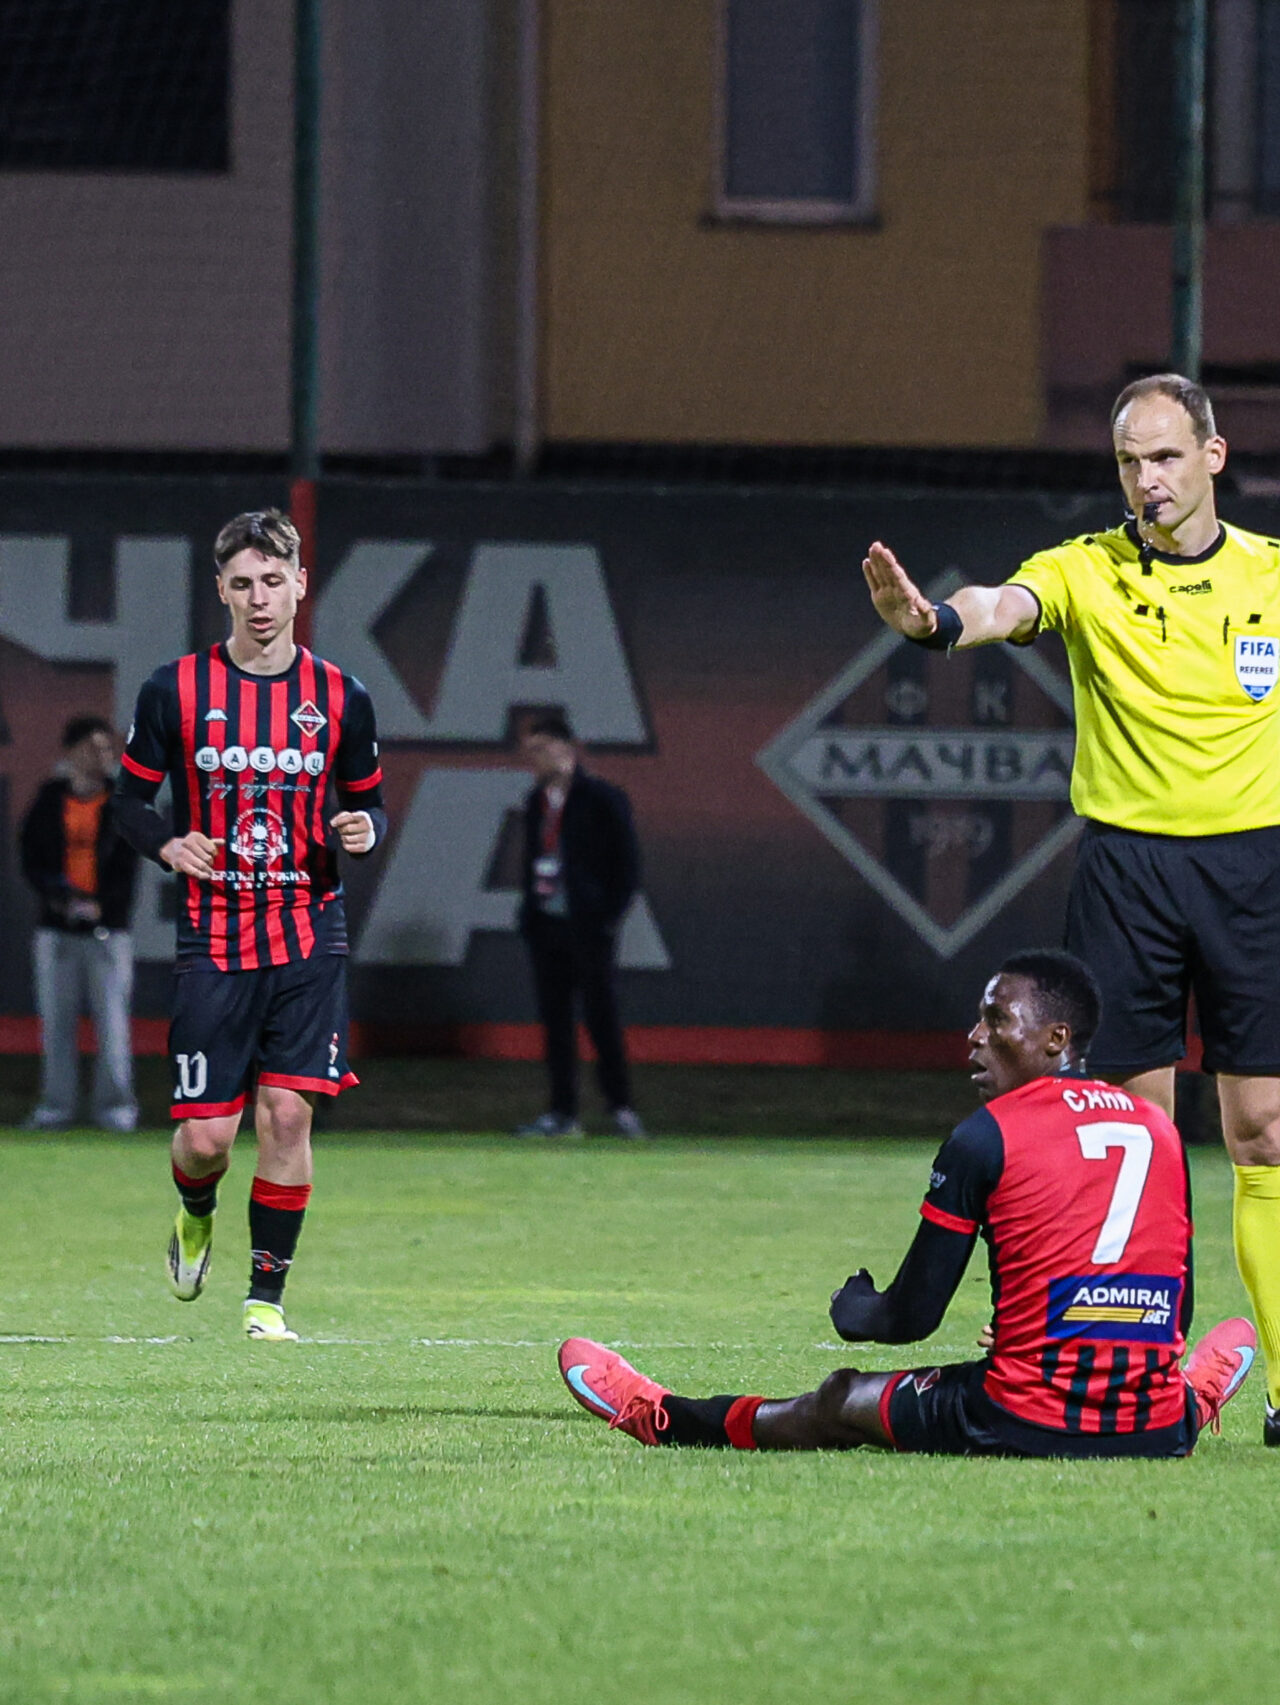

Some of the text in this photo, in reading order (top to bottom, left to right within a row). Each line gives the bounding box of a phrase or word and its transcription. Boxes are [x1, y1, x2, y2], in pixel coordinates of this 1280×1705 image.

[1240, 641, 1275, 657] FIFA
[1239, 665, 1274, 675] REFEREE
[198, 750, 322, 773] ШАБАЦ
[174, 1051, 208, 1099] 10
[1075, 1121, 1154, 1265] 7
[1072, 1287, 1171, 1309] ADMIRAL
[1142, 1309, 1171, 1325] BET
